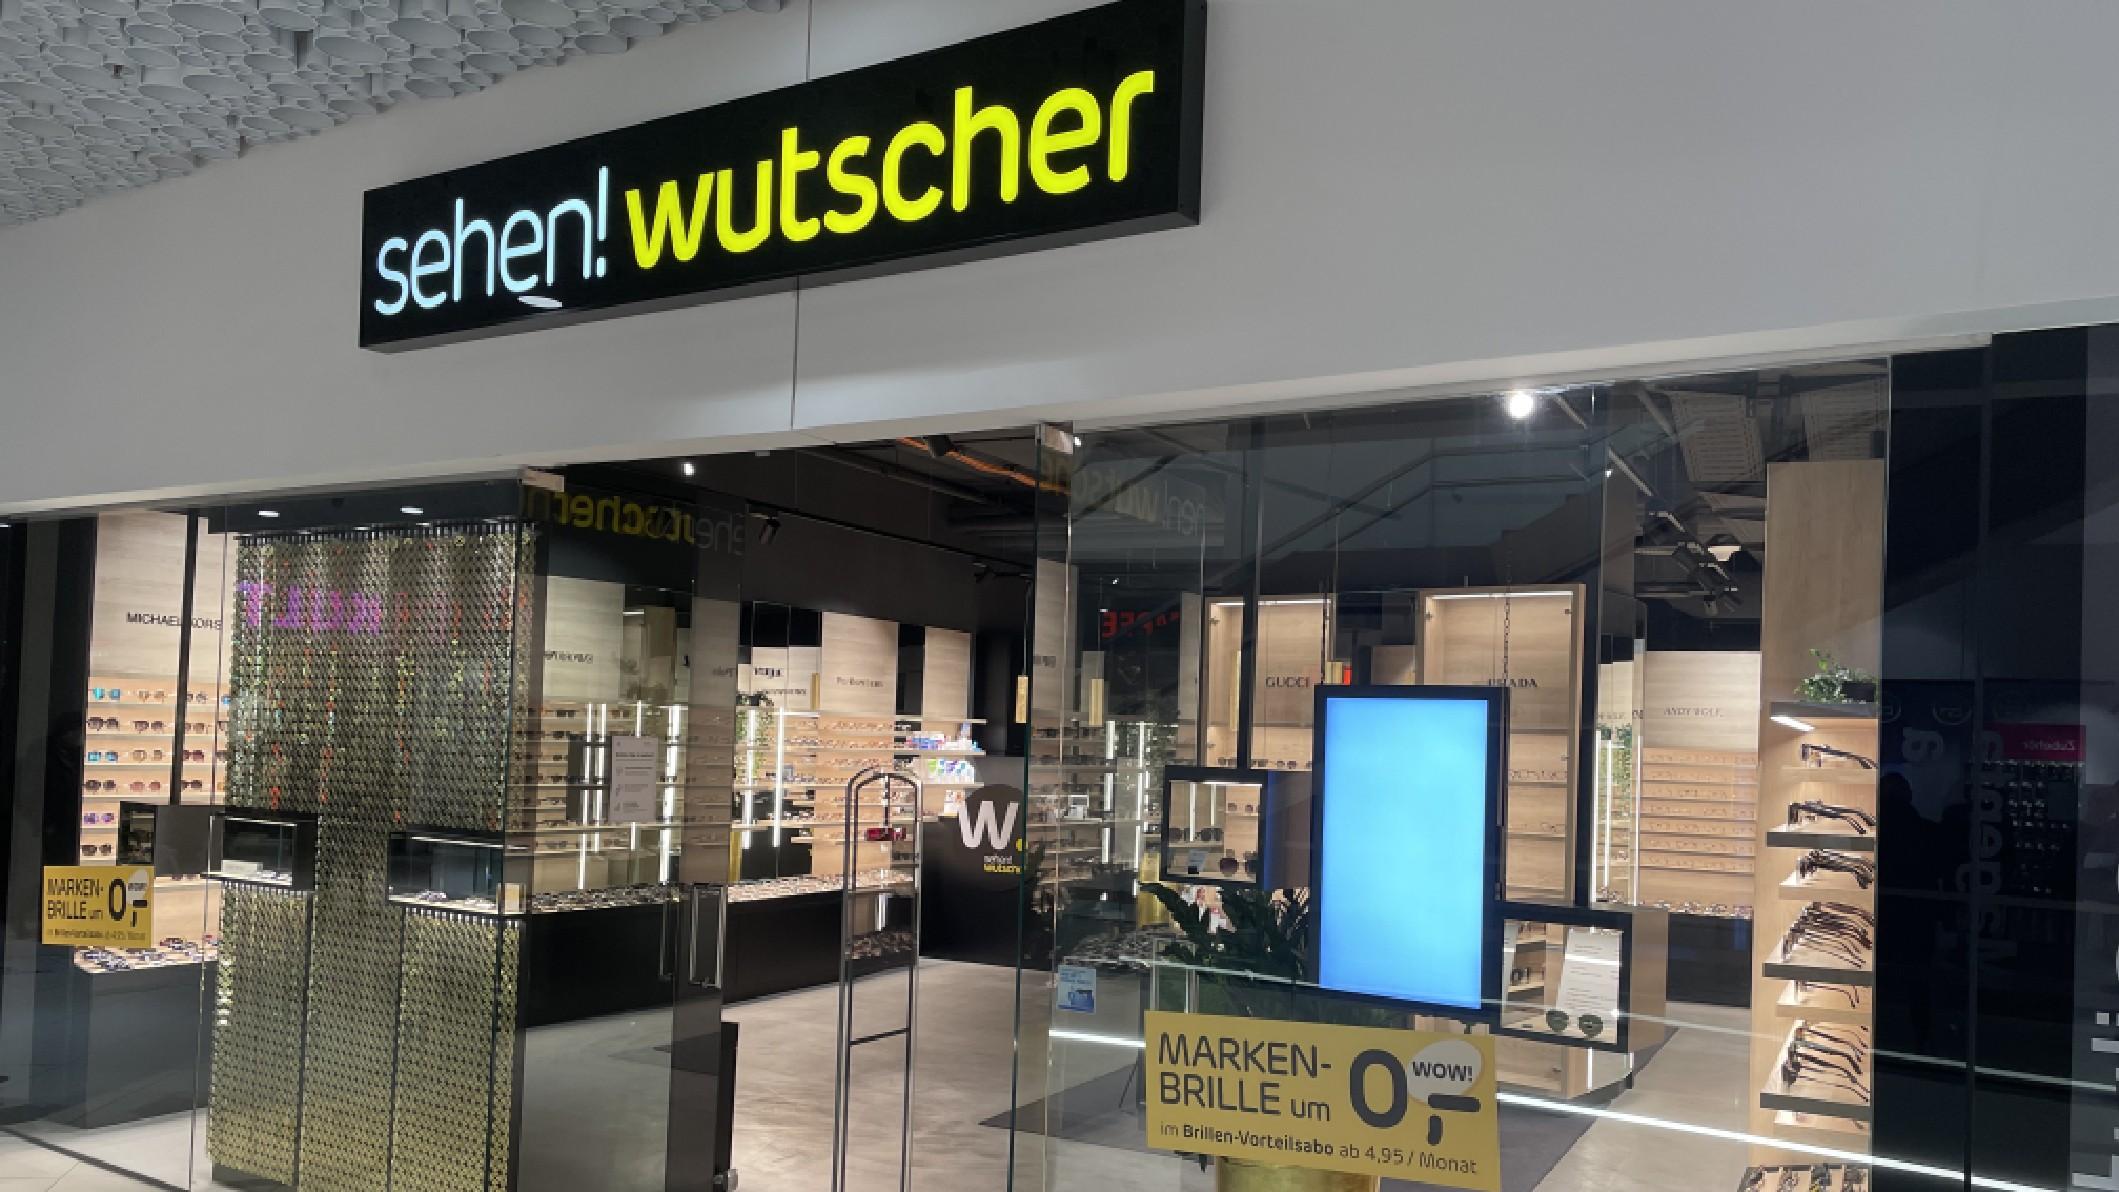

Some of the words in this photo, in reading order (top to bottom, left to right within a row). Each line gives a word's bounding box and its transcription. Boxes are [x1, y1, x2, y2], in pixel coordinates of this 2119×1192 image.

[374, 166, 608, 316] sehen!
[626, 70, 1154, 270] wutscher
[1266, 676, 1311, 689] GUCCI
[48, 878, 103, 895] MARKEN-
[48, 899, 86, 919] BRILLE
[1158, 1031, 1332, 1077] MARKEN-
[1411, 1060, 1473, 1083] WOW!
[1160, 1071, 1281, 1115] BRILLE
[1290, 1097, 1331, 1122] um
[1160, 1122, 1178, 1137] im
[1182, 1124, 1334, 1157] Brillen-Vorteilsabo
[1340, 1143, 1361, 1160] ab
[1365, 1146, 1403, 1166] 4,95
[1419, 1151, 1477, 1174] Monat
